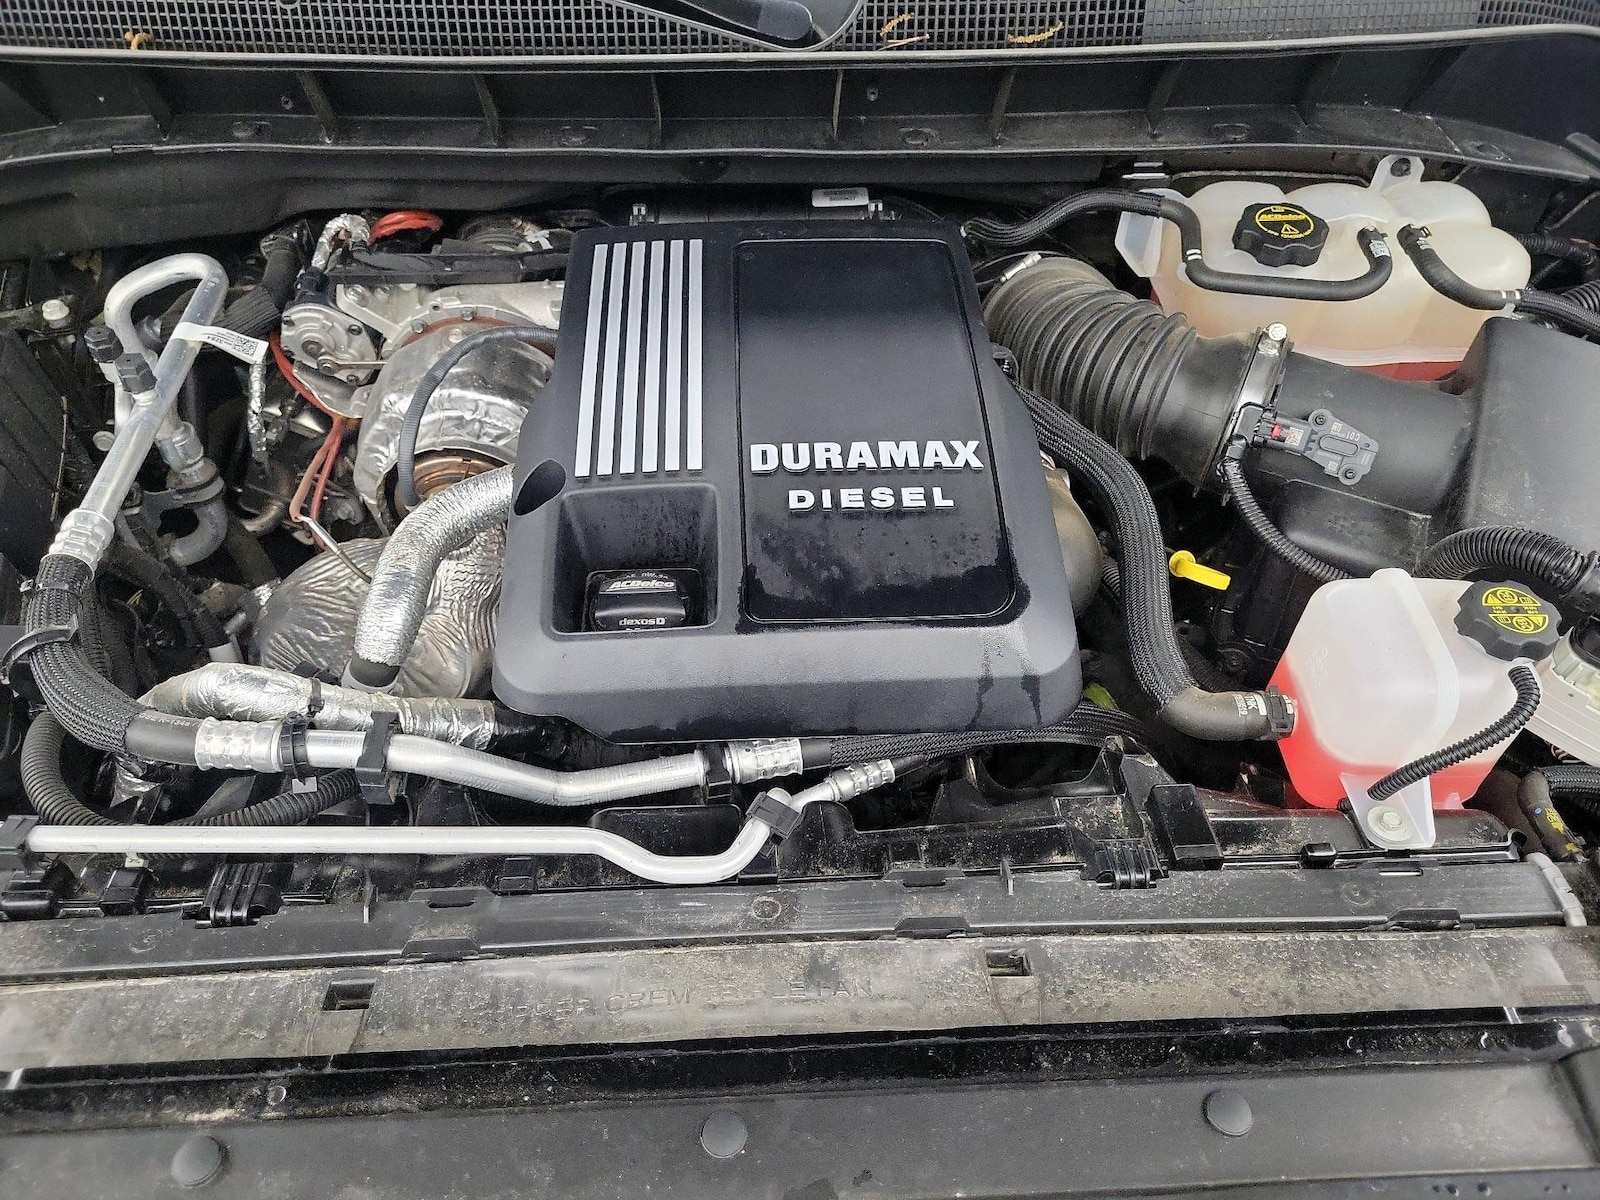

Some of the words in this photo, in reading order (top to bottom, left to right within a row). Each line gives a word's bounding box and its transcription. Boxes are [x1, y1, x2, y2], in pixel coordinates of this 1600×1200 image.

[750, 440, 984, 474] DURAMAX
[788, 486, 955, 511] DIESEL
[606, 580, 675, 592] ACDelco
